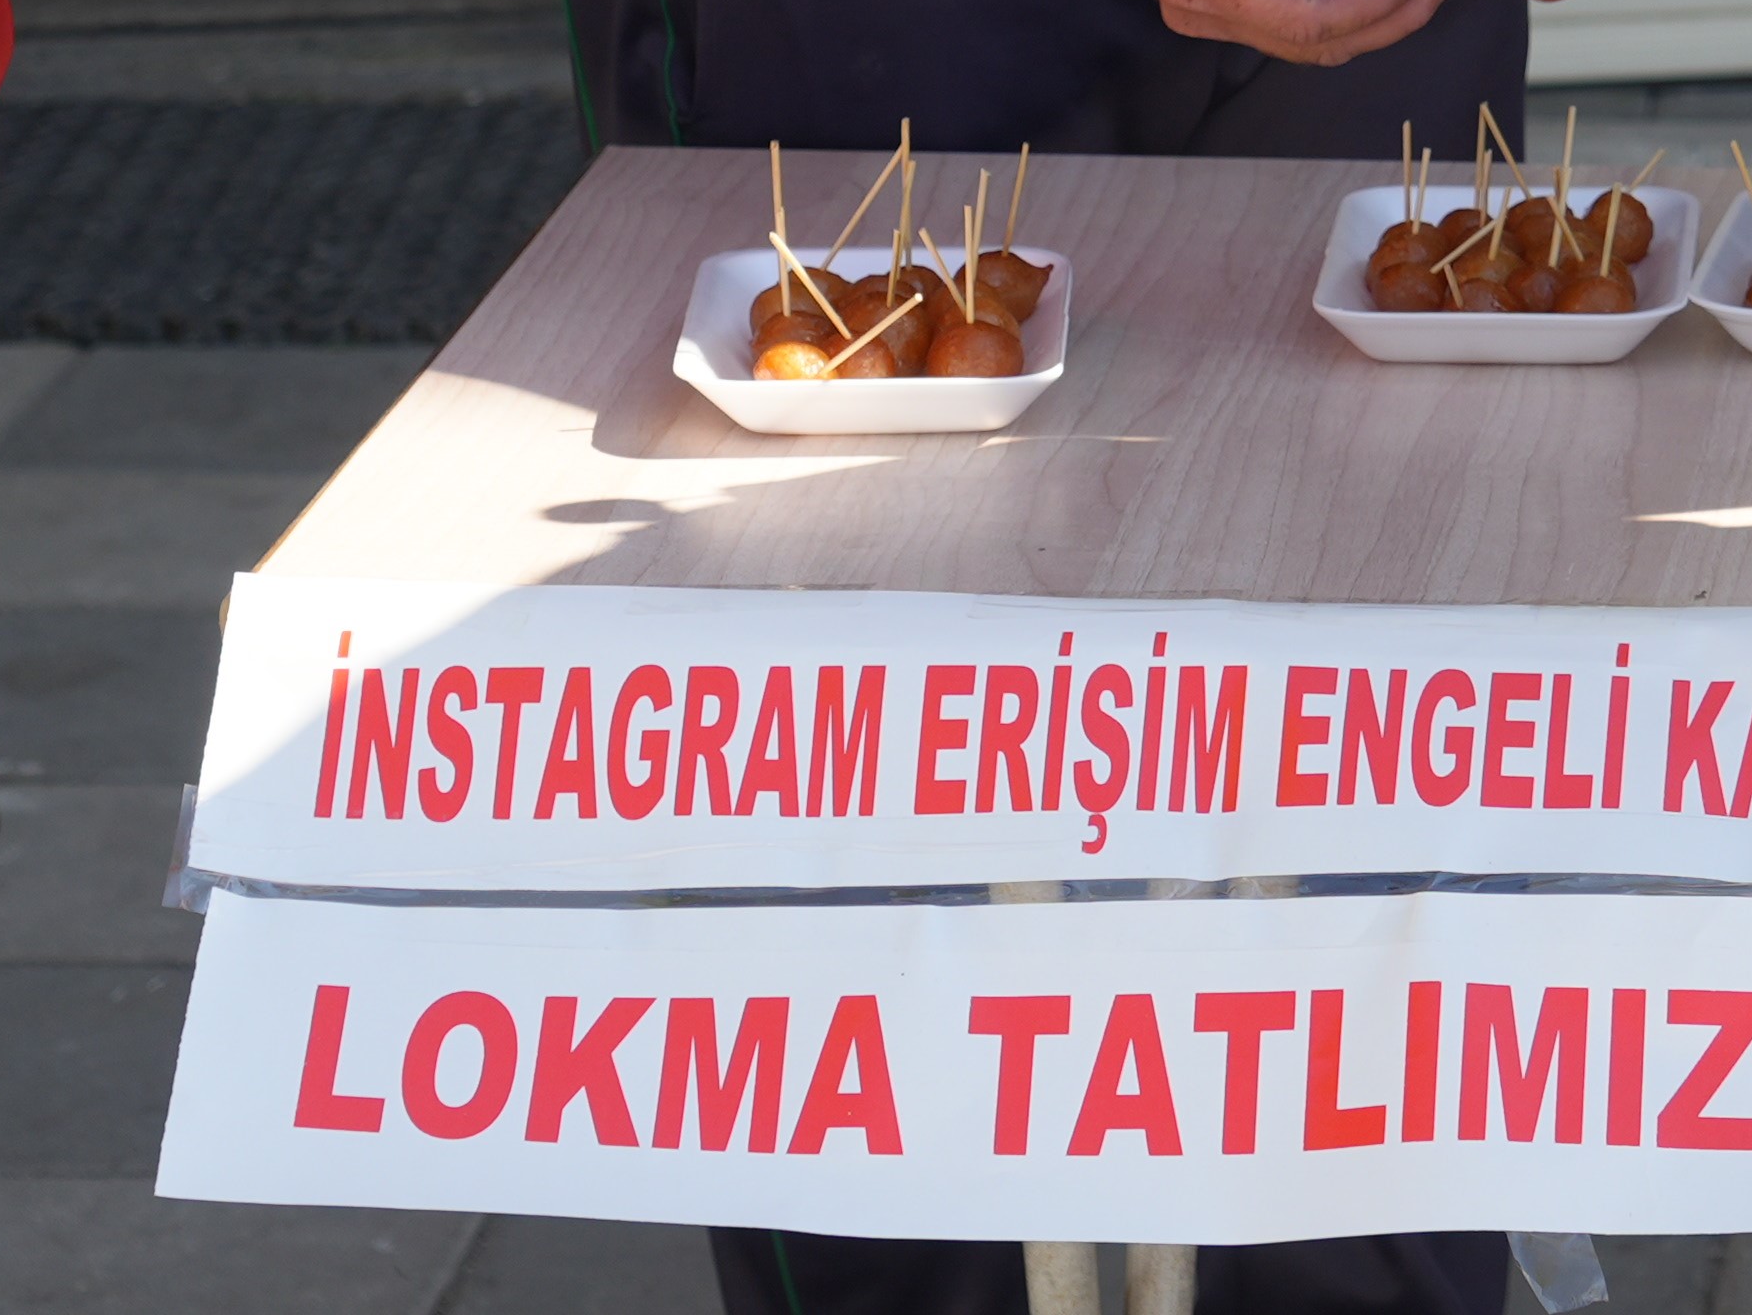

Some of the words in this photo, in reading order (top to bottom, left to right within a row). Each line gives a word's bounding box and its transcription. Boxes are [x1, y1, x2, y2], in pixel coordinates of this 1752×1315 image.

[313, 629, 886, 823] İNSTAGRAM
[912, 629, 1248, 855] ERİŞİM
[1274, 641, 1631, 809] ENGELİ
[293, 983, 904, 1156] LOKMA
